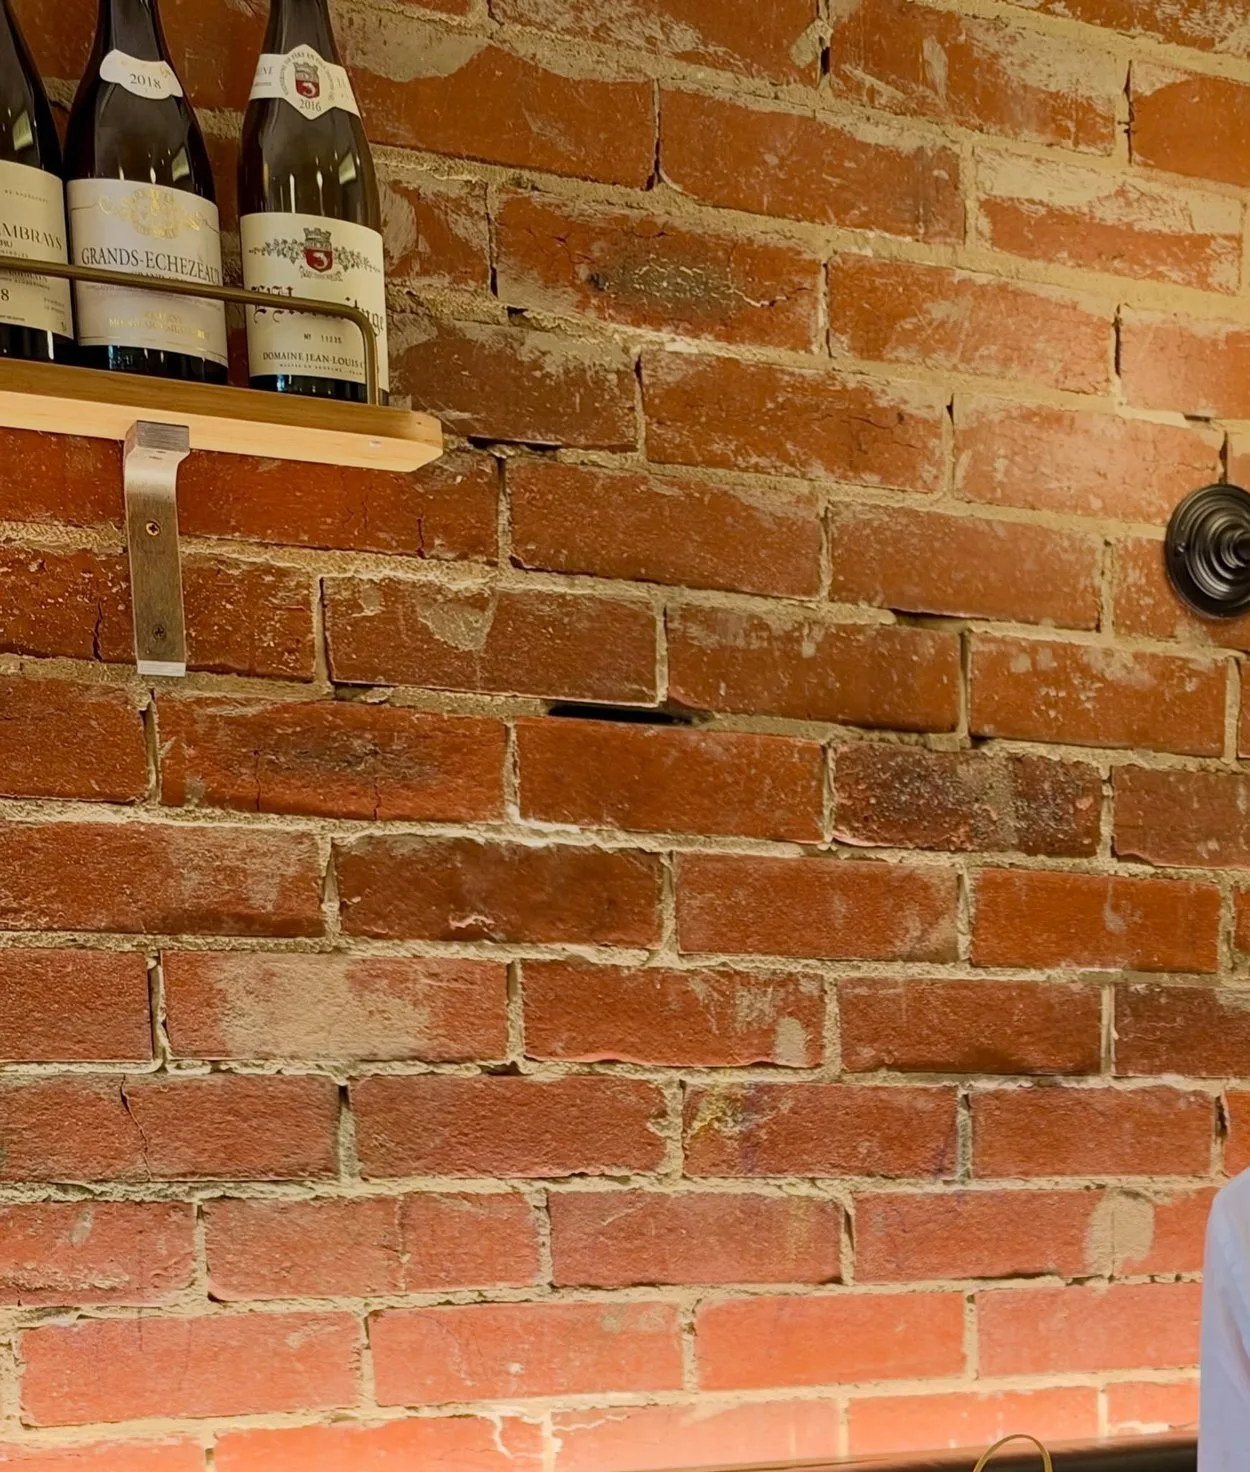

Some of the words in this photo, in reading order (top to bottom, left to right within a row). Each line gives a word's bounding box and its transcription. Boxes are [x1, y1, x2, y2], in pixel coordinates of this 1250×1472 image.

[129, 73, 162, 89] 2018
[300, 100, 322, 112] 2016
[262, 351, 303, 361] DOMAINE
